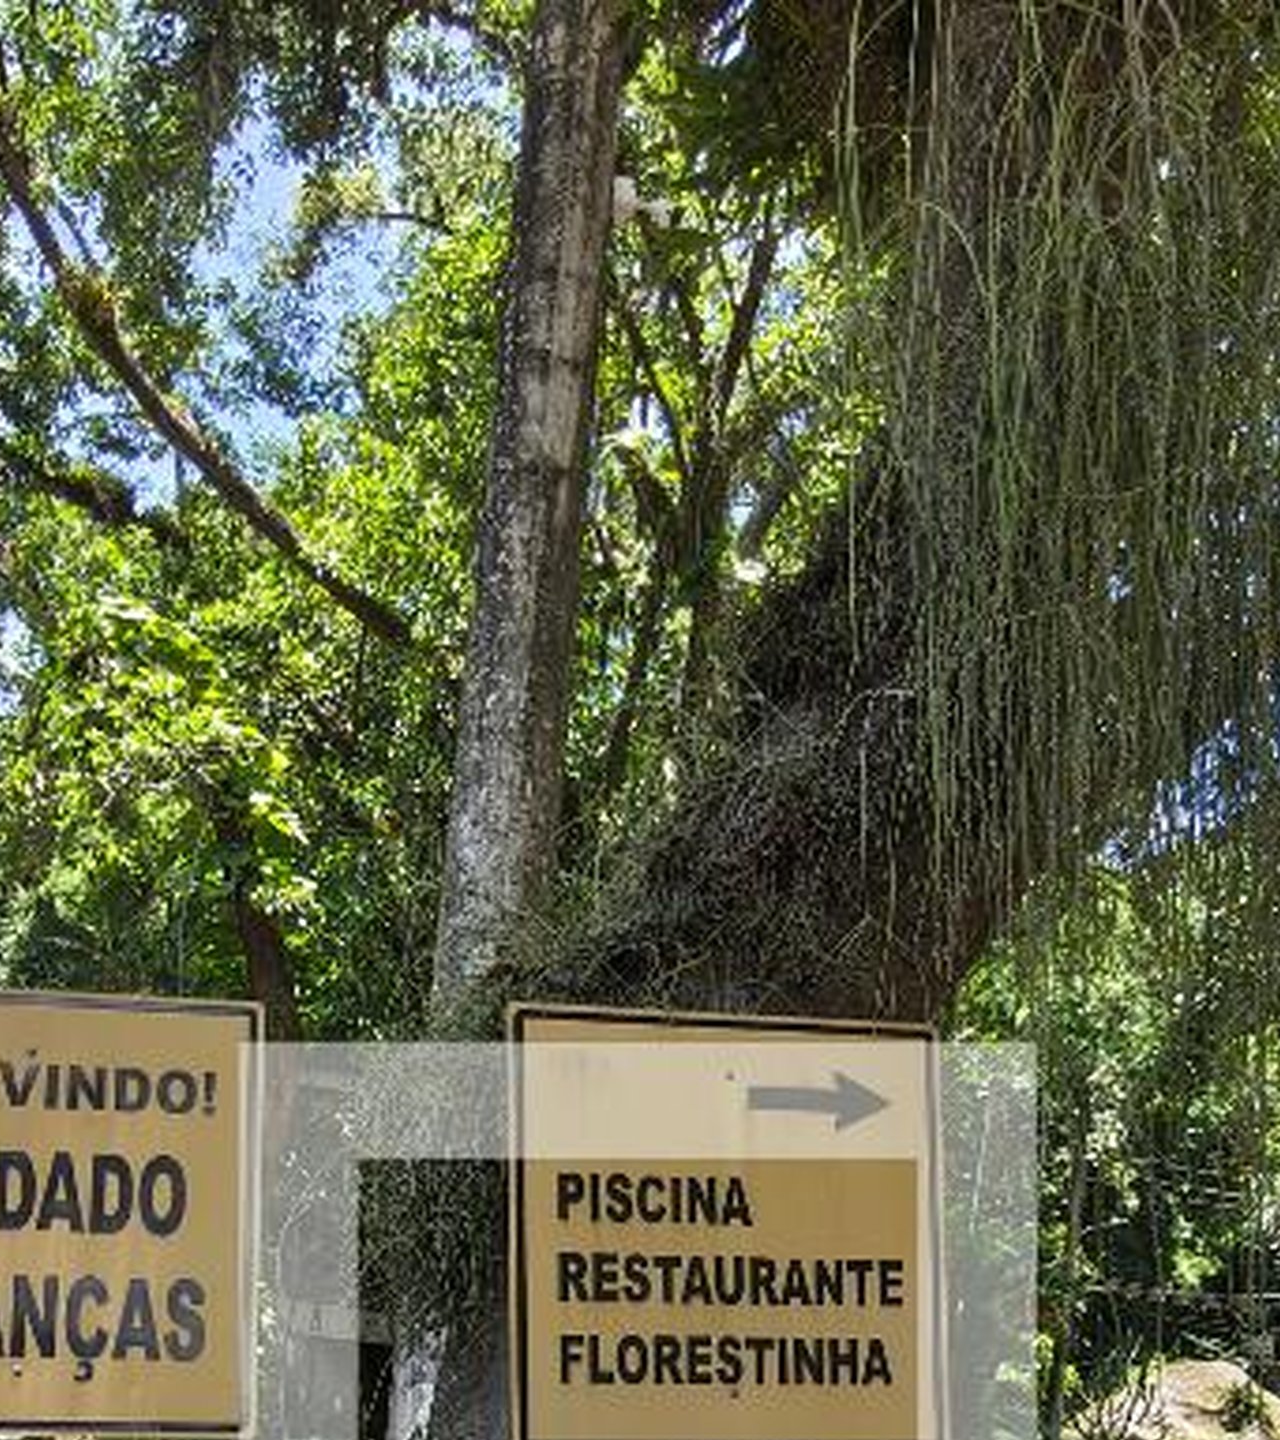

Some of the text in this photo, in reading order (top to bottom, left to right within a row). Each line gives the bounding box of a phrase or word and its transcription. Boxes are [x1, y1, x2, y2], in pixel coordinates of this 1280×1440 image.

[556, 1173, 753, 1227] PISCINA
[557, 1253, 904, 1306] RESTAURANTE
[559, 1334, 894, 1386] FLORESTINHA
